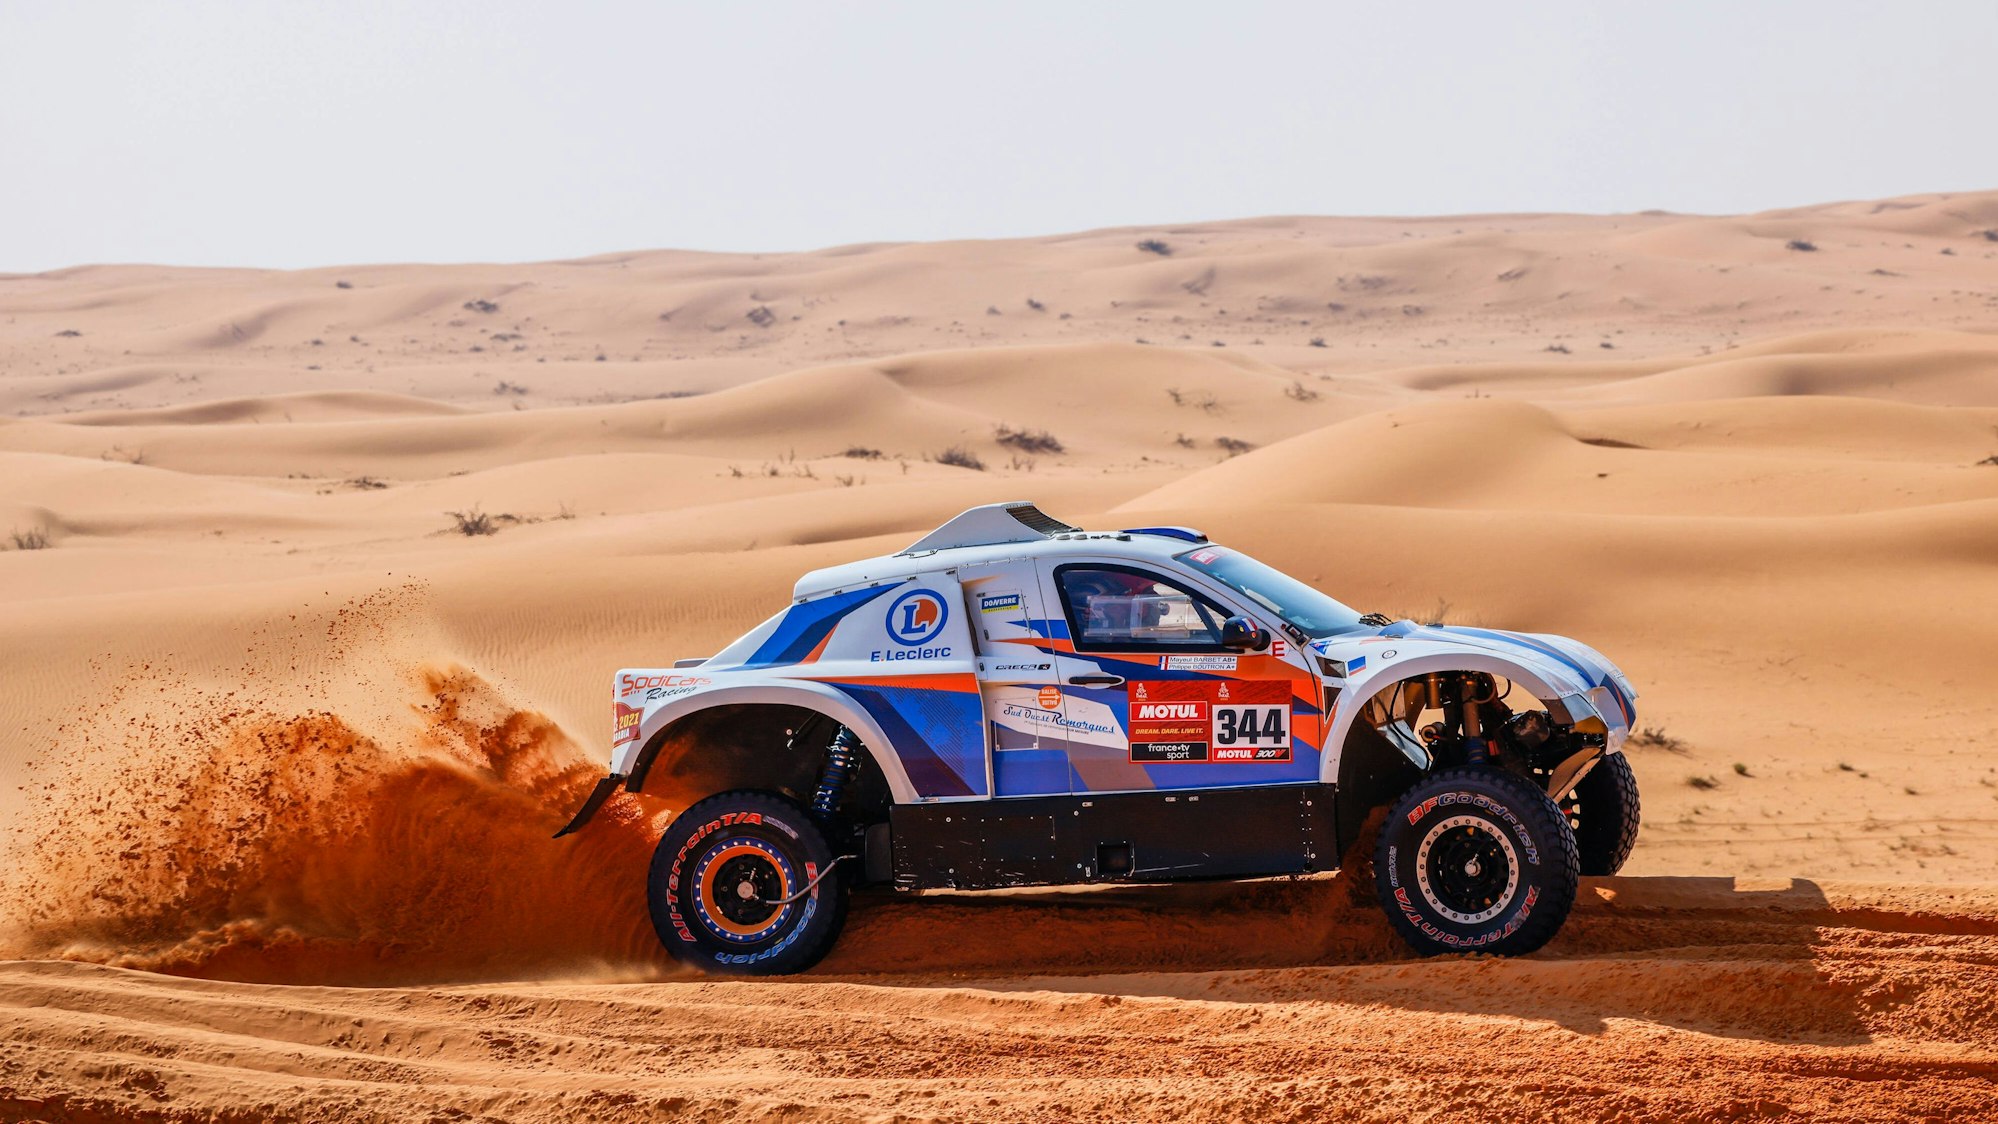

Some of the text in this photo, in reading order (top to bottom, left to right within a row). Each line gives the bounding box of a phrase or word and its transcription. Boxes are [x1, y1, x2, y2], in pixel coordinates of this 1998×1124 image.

[871, 647, 951, 662] E.Leclerc
[1271, 641, 1285, 657] E
[645, 686, 697, 704] Racing
[1139, 705, 1198, 718] MOTUL
[619, 713, 639, 729] 2021
[1051, 712, 1116, 734] Remorques
[1217, 709, 1286, 744] 344
[1167, 751, 1189, 760] sport
[1217, 750, 1286, 758] MOTUL 300V
